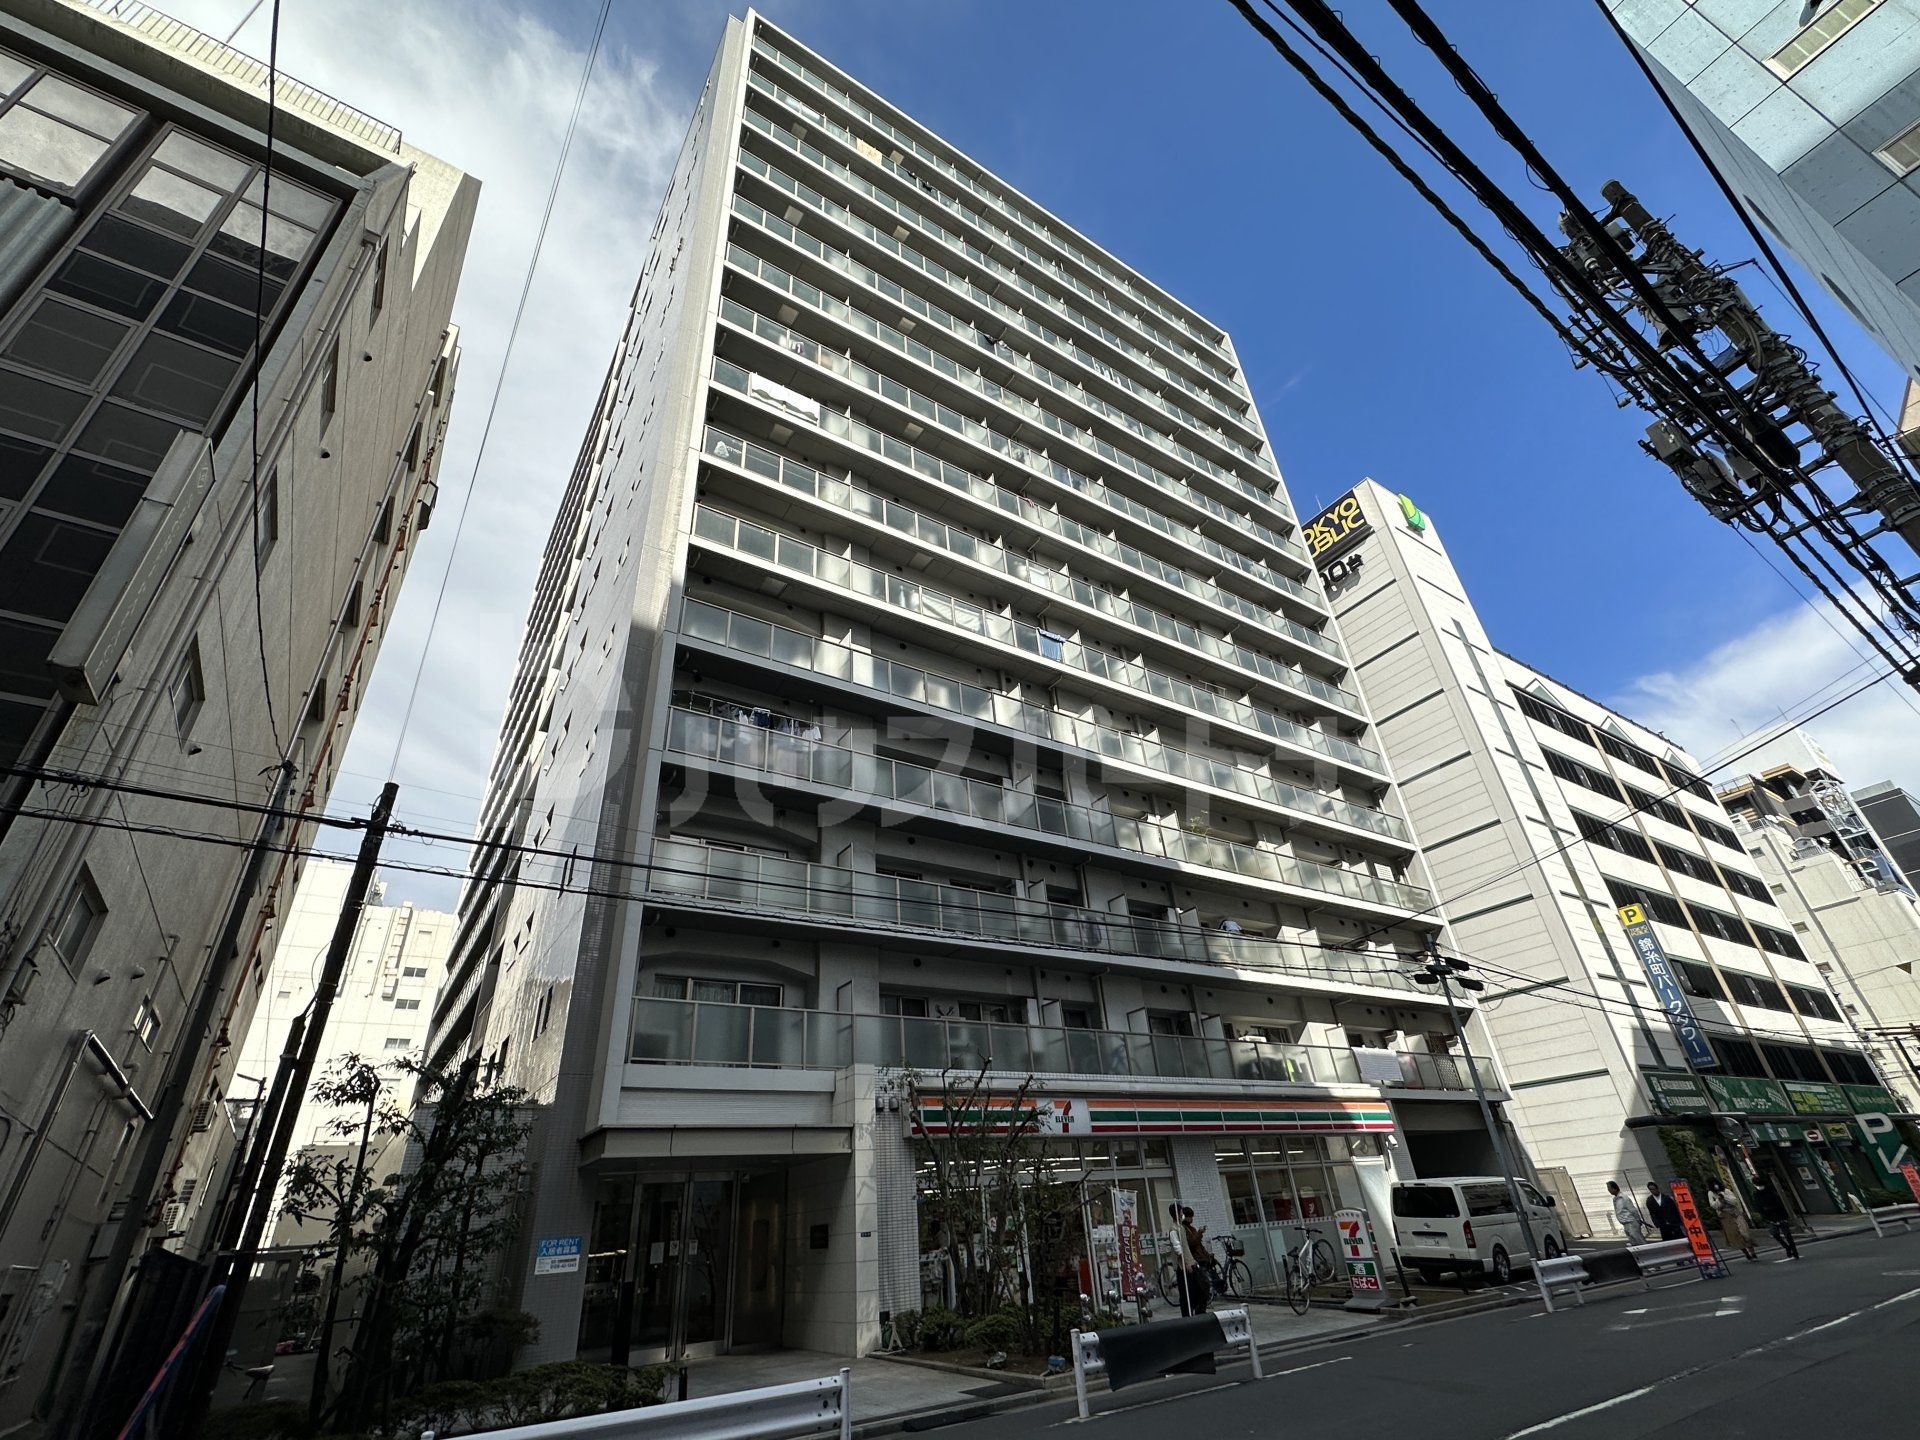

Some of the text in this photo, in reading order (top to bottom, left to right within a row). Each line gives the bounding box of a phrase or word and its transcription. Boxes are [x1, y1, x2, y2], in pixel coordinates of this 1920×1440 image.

[1303, 497, 1357, 546] OKYO
[1311, 509, 1365, 557] UBLIC
[1624, 909, 1637, 923] P
[1854, 1112, 1894, 1145] P
[541, 1237, 579, 1248] FOR RENT
[1352, 1263, 1366, 1275] 酒
[1352, 1276, 1378, 1289] たばこ
